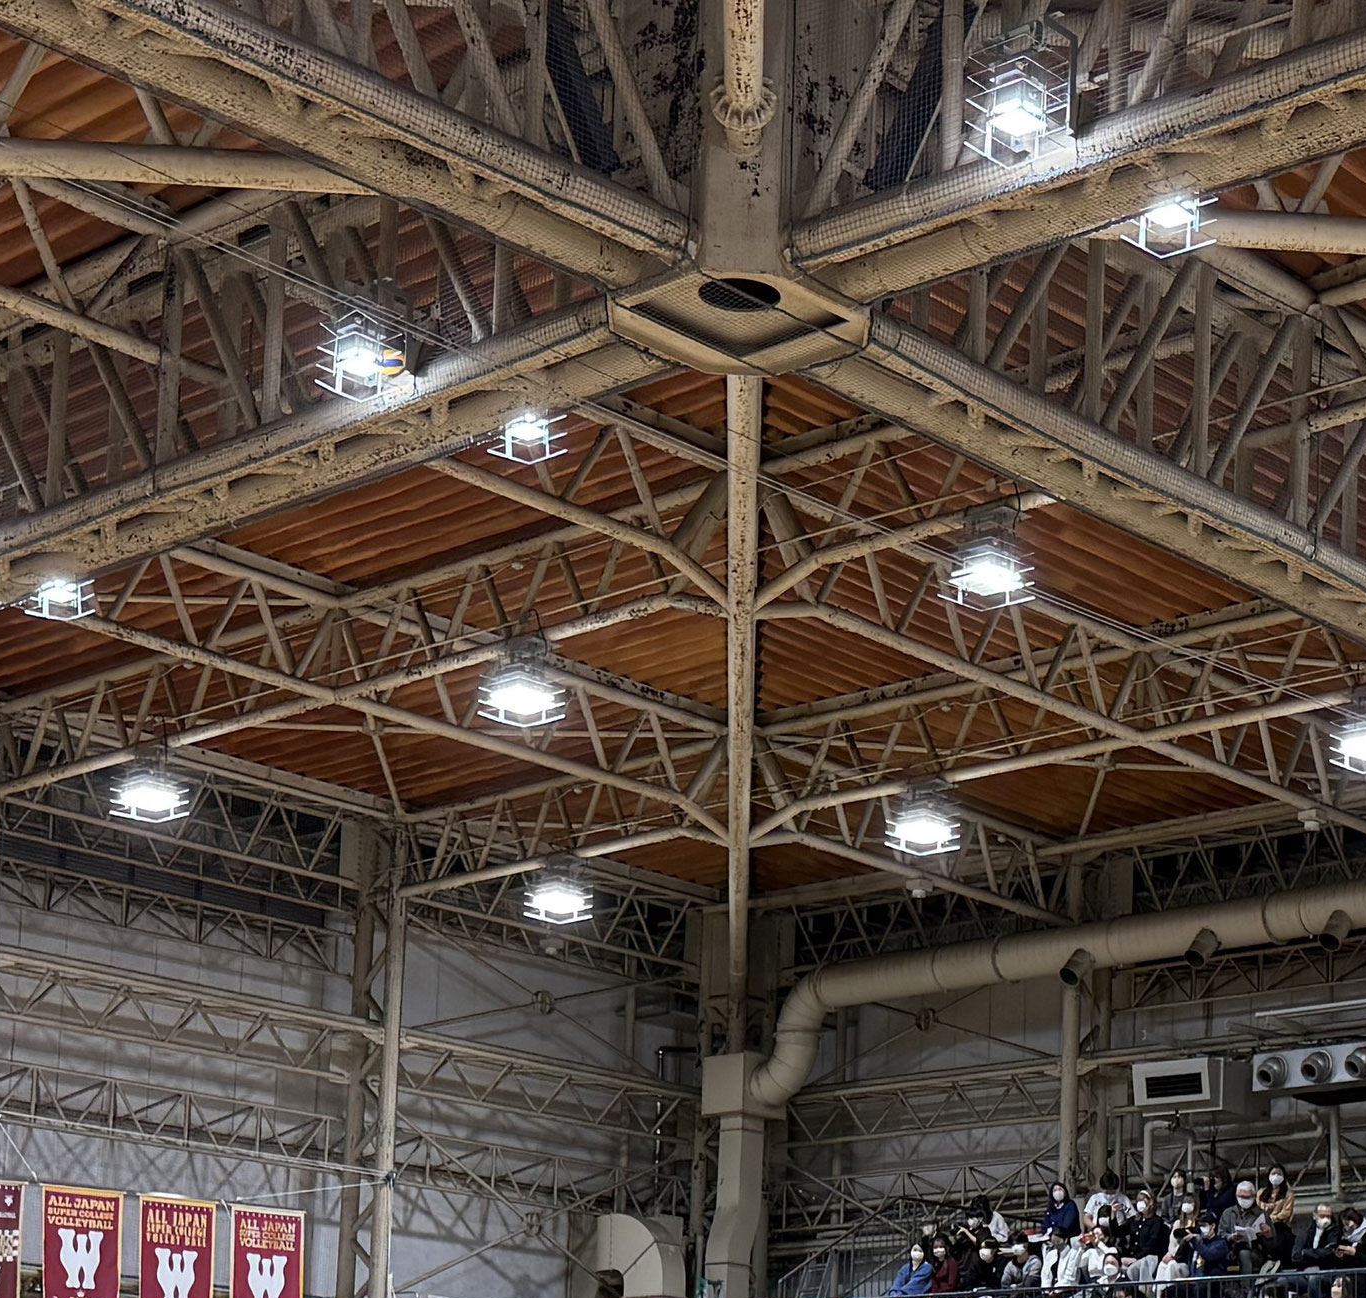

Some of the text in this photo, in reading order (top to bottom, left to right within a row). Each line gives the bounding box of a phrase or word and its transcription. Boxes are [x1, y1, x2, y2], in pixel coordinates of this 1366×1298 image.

[48, 1195, 115, 1212] ALL JAPAN
[47, 1207, 114, 1220] SUPER COLLEGE
[147, 1208, 207, 1227] ALL JAPAN
[47, 1215, 114, 1230] VOLLEYBALL
[240, 1218, 296, 1233] ALL JAPAN
[239, 1238, 295, 1252] VOLLEYBALL
[57, 1228, 104, 1290] W
